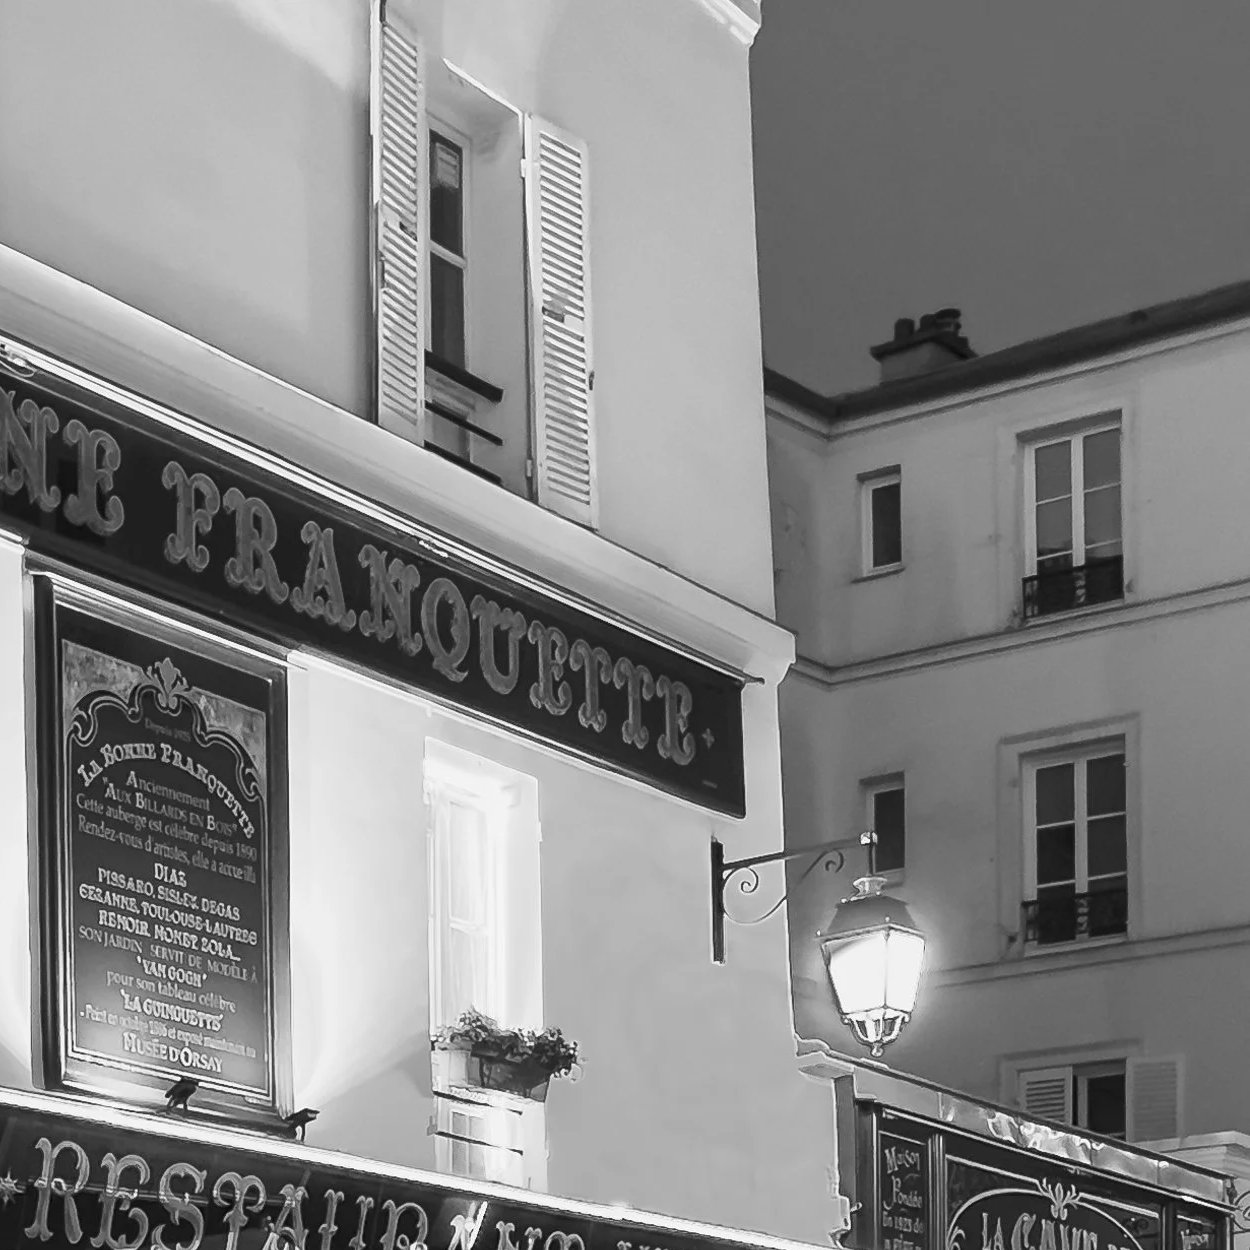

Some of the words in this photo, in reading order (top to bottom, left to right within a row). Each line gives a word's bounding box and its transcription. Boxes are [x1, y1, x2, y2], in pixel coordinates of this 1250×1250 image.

[161, 461, 696, 764] FRANQUETTE
[78, 760, 103, 787] LA
[100, 743, 156, 769] BONNE
[160, 743, 255, 839] FRANQUETTE
[126, 771, 210, 811] Anciennement
[135, 792, 187, 824] BILLARDS
[76, 792, 103, 814] Cette
[105, 802, 146, 831] auberge
[148, 817, 162, 832] est
[201, 832, 233, 859] depuis
[154, 862, 187, 887] DIAZ
[201, 898, 240, 921] DEGAS
[78, 925, 102, 942] SON
[103, 932, 142, 955] JARDIN
[150, 944, 183, 963] SERVIT
[188, 955, 201, 968] DE
[106, 971, 134, 990] pour
[136, 978, 155, 991] son
[158, 980, 195, 1001] tableau
[123, 1031, 167, 1059] MUSÉE
[169, 1043, 222, 1073] D'ORSAY
